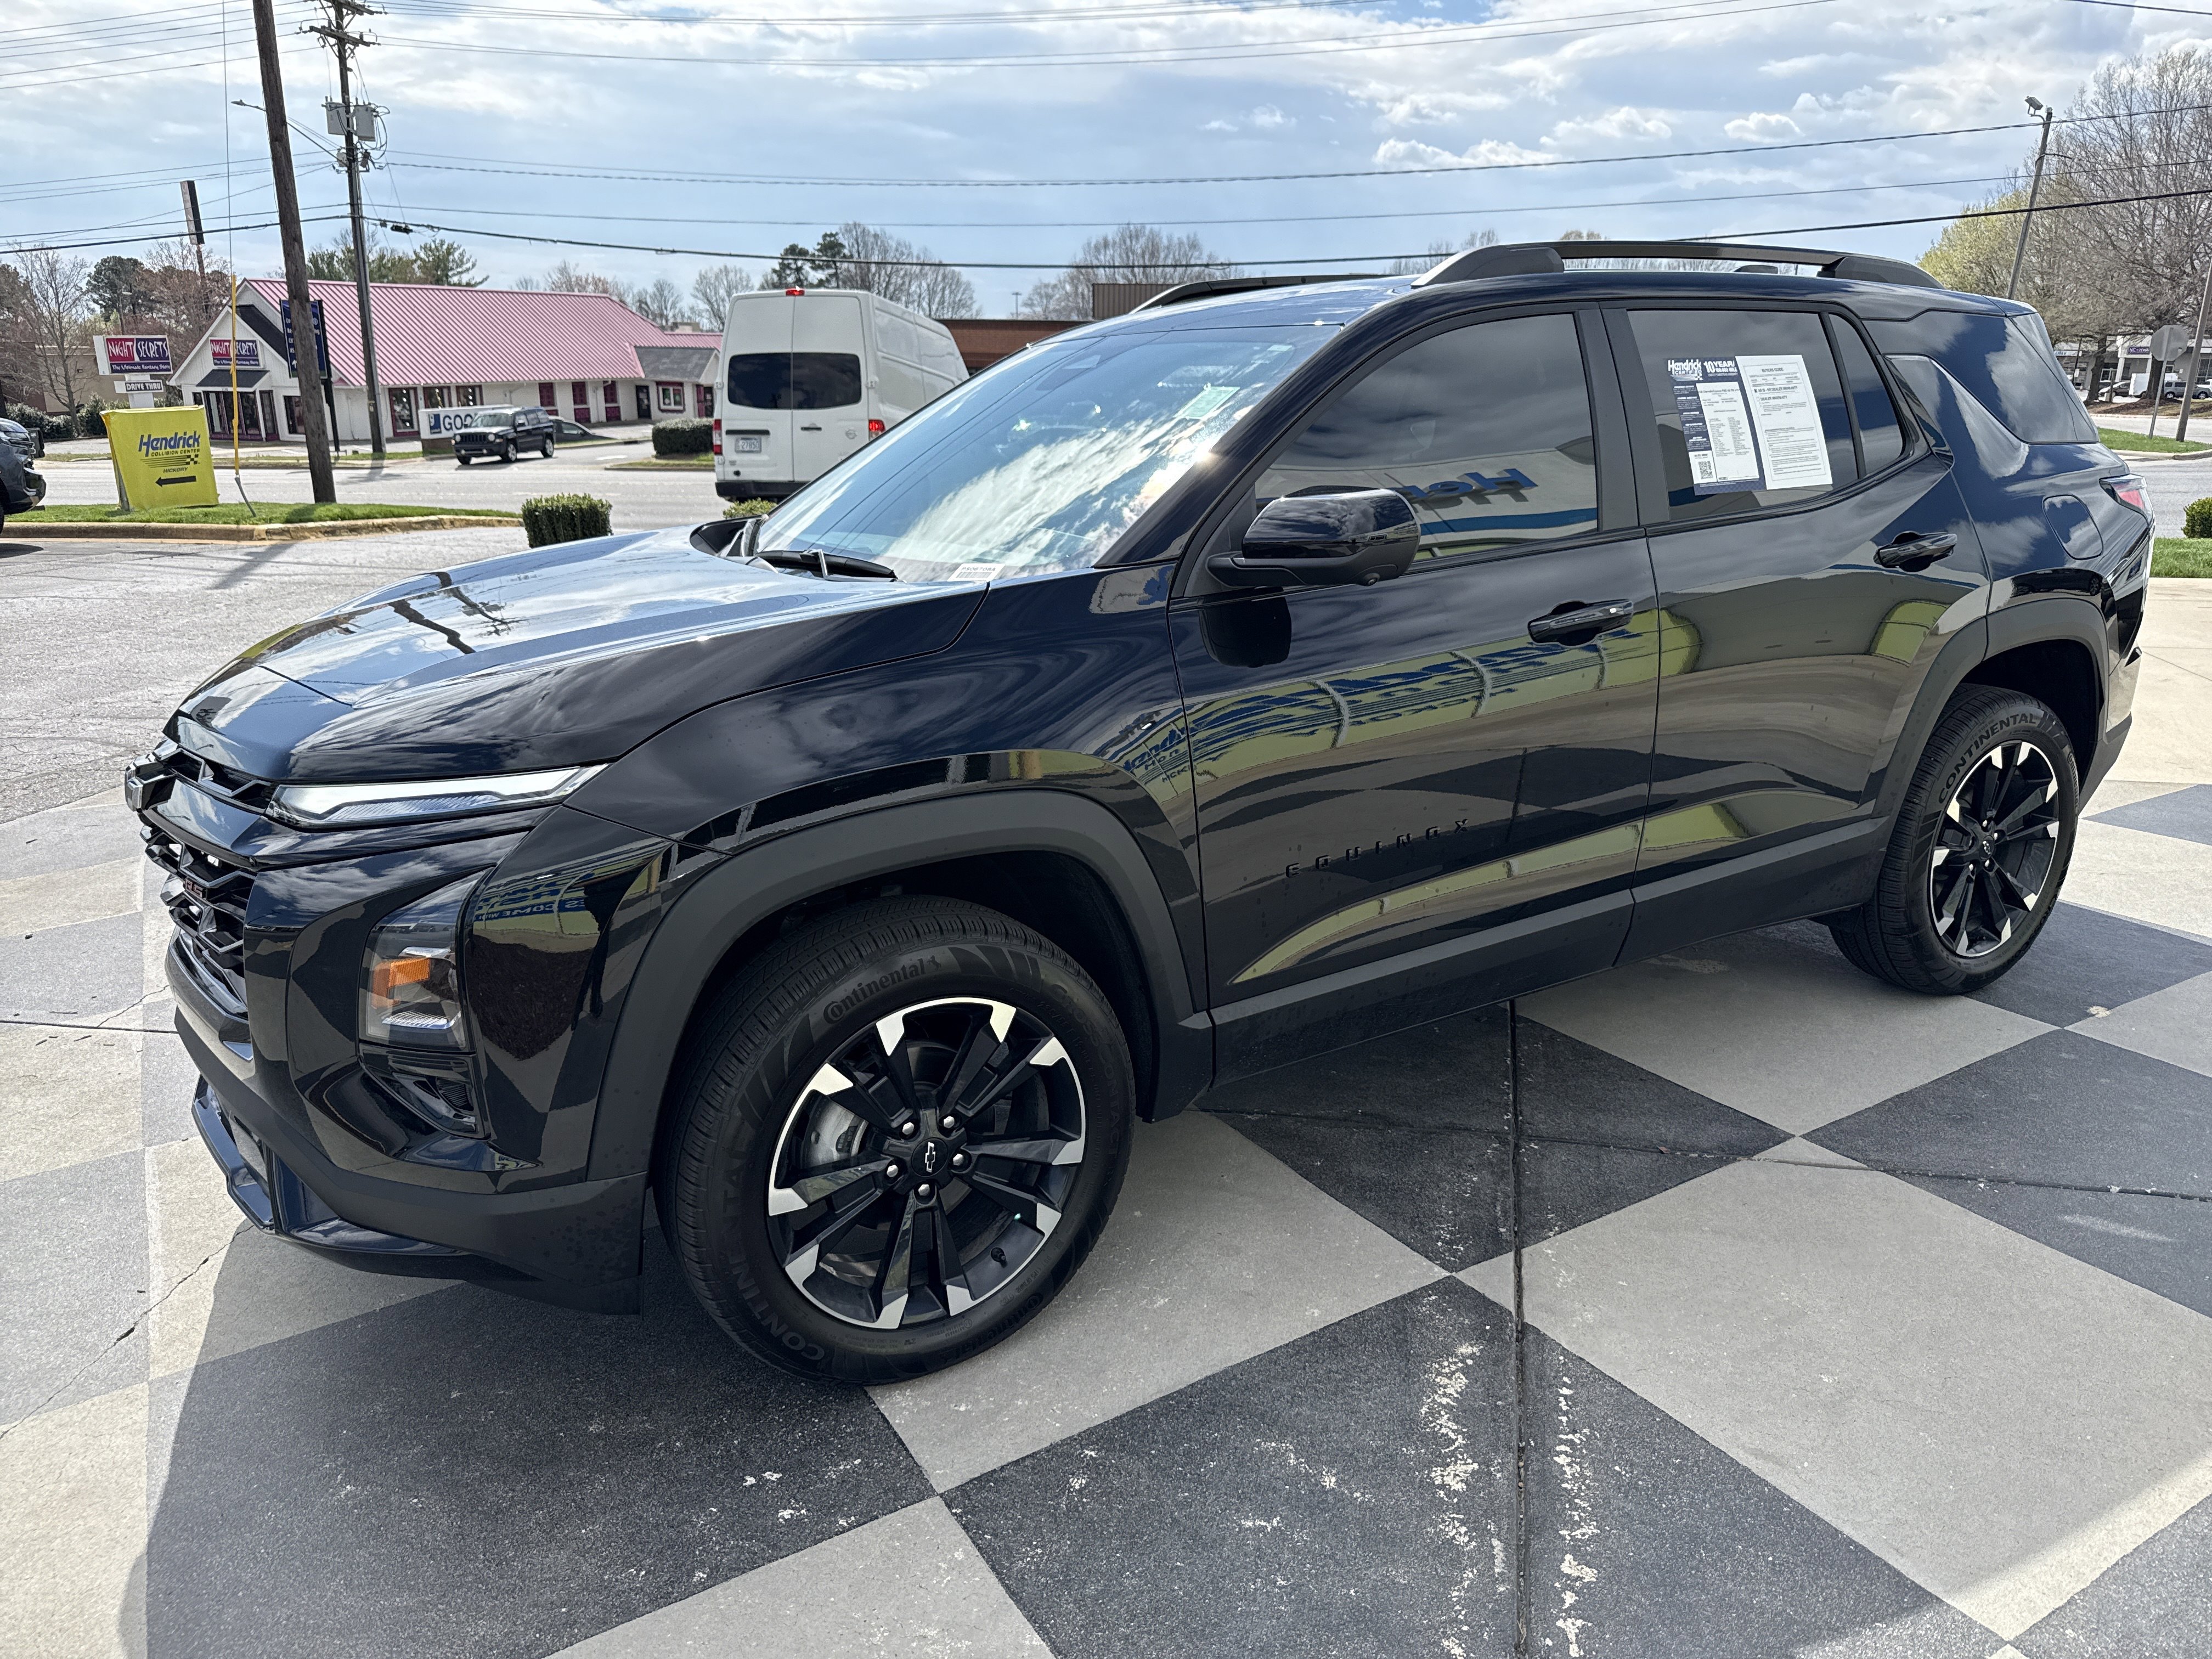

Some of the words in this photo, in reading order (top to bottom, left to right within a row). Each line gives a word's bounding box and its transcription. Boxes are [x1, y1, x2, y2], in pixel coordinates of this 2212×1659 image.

[137, 341, 168, 358] SECRETS
[234, 341, 257, 355] ECRETS
[1668, 359, 1702, 375] Hendrick
[1703, 360, 1716, 373] 10
[126, 382, 144, 391] DRIVE
[138, 431, 200, 457] Hendrick
[1938, 713, 2036, 804] CONTINENTAL
[1285, 818, 1469, 878] EQUINOX
[185, 878, 203, 899] RS
[823, 957, 926, 1024] Continental
